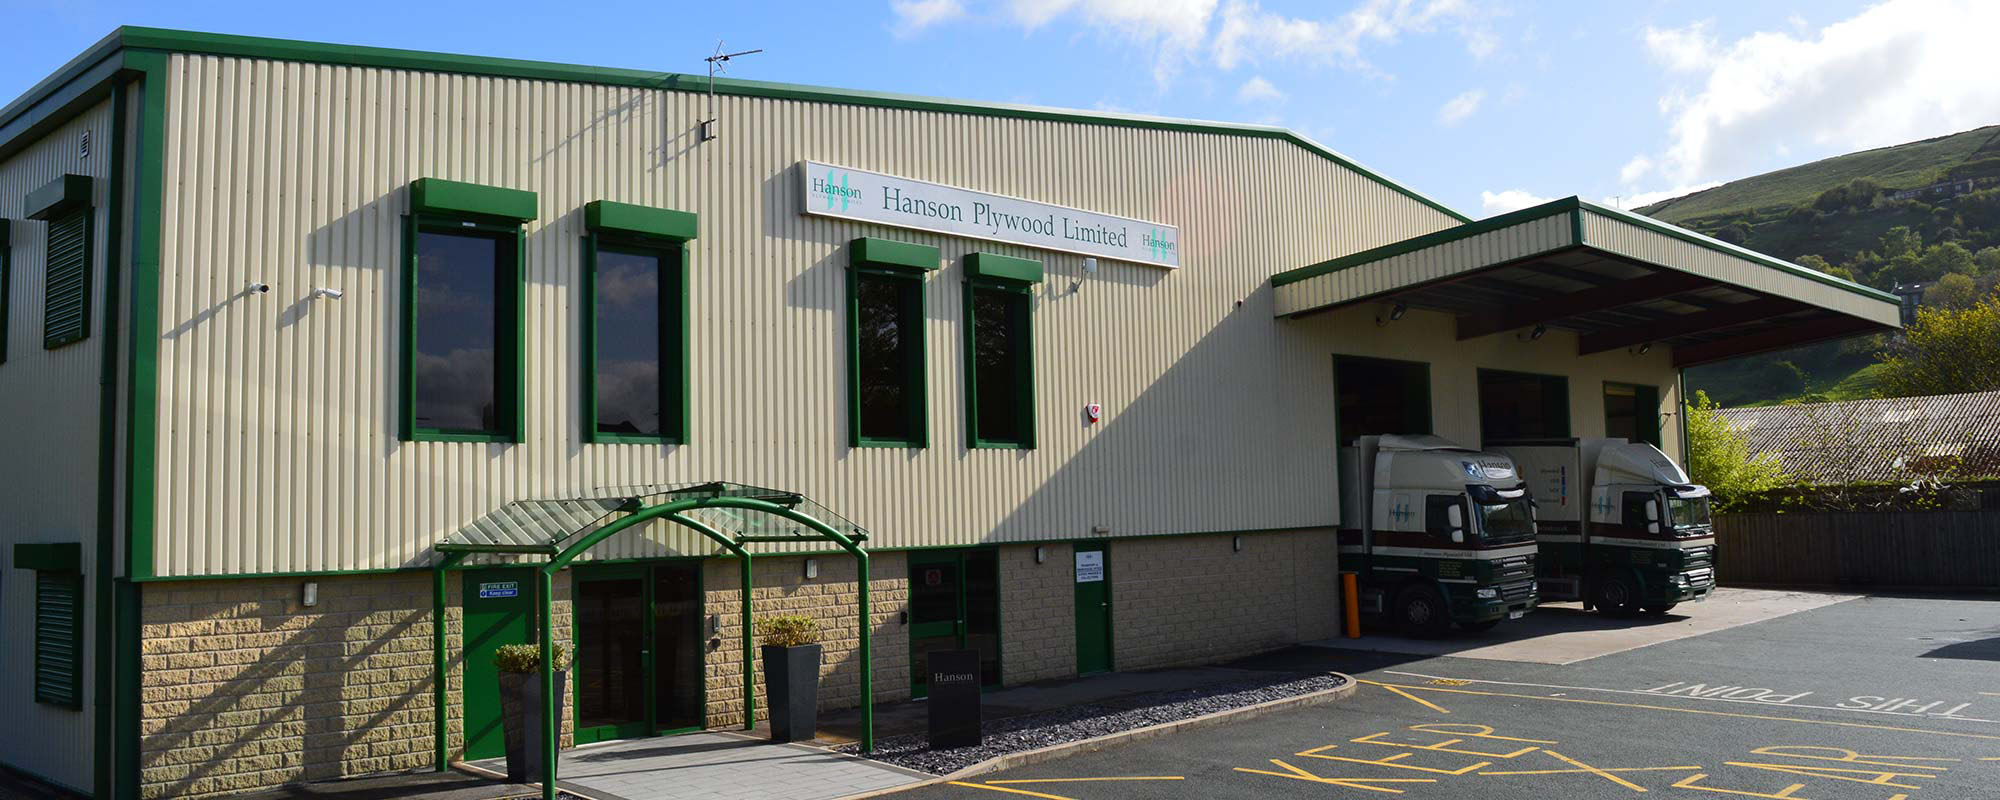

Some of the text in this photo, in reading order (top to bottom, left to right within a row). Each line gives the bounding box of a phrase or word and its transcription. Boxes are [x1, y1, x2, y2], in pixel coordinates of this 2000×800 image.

[812, 177, 862, 200] Hanson
[882, 186, 1128, 248] Hanson Plywood Limited
[1141, 232, 1176, 252] Hanson
[935, 672, 974, 682] Hanson
[1637, 681, 1972, 718] THIS POINT
[1232, 723, 1559, 793] KEEP
